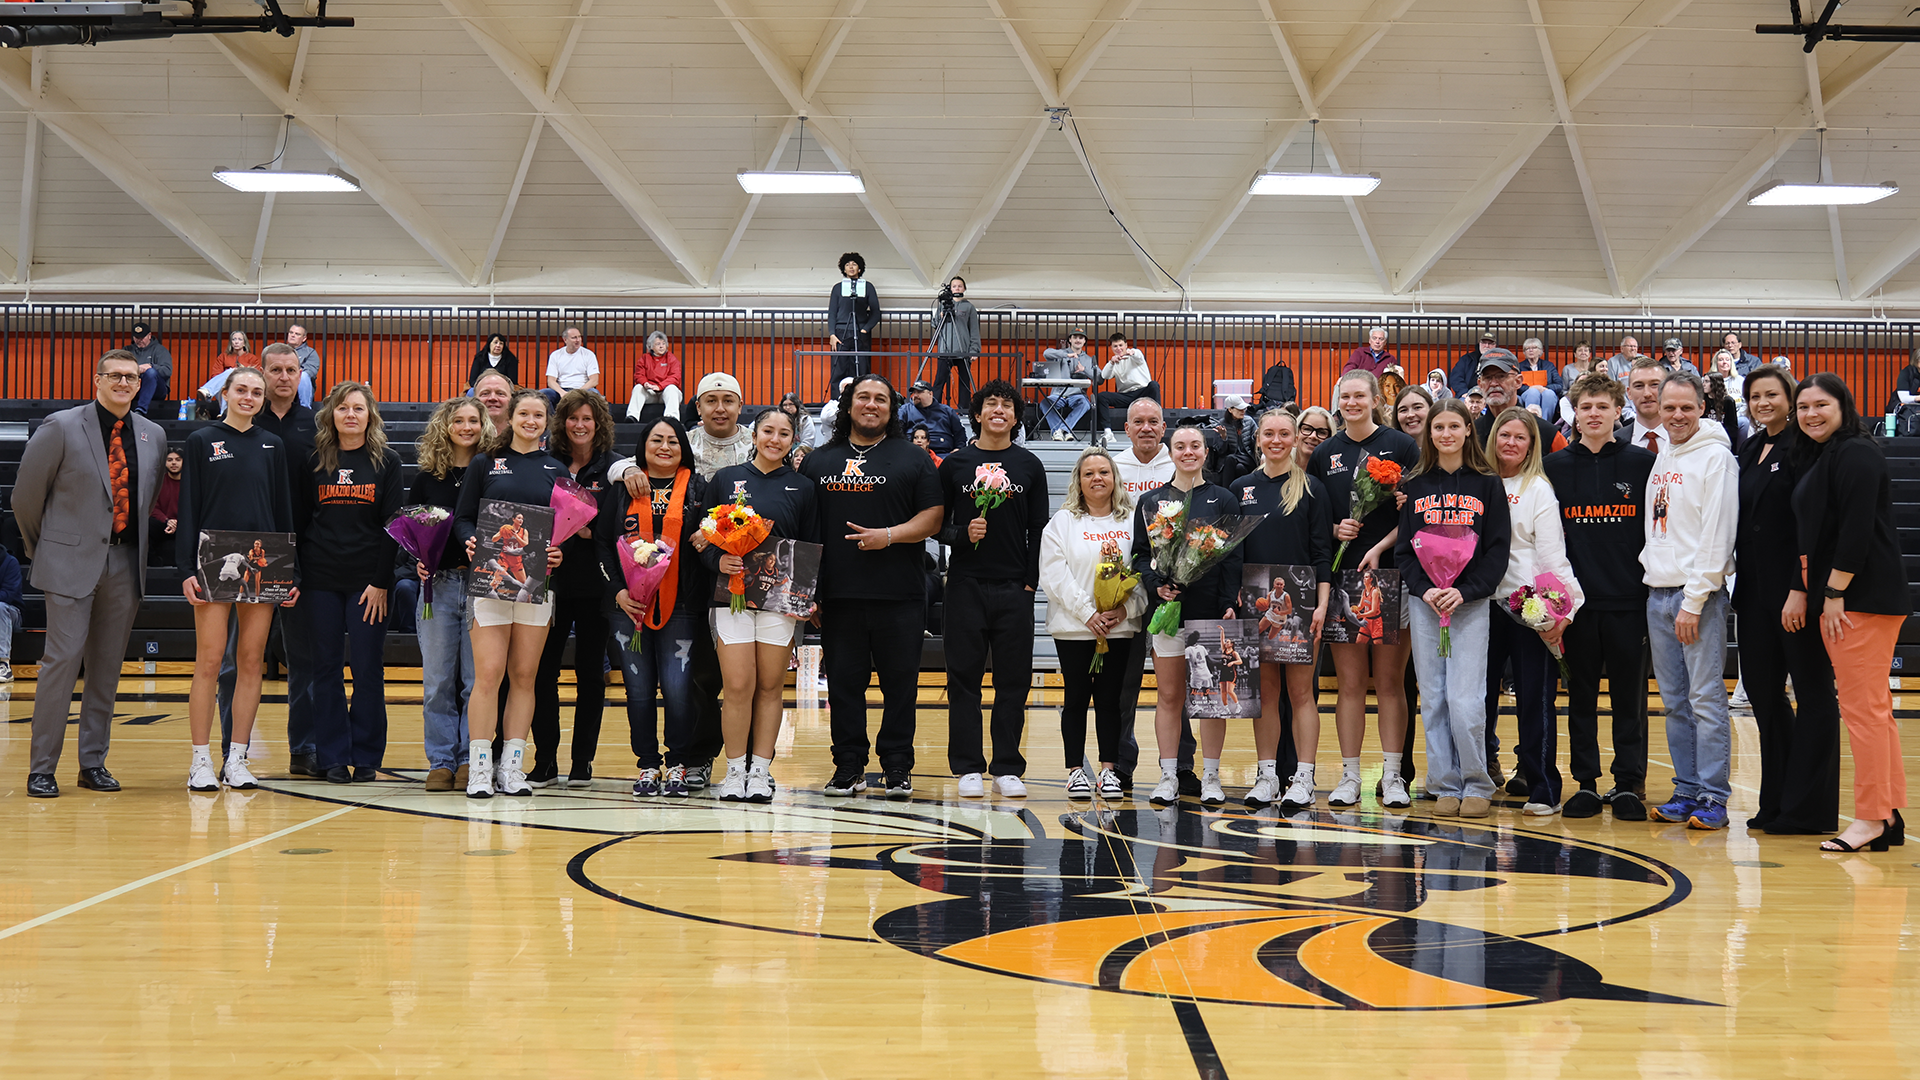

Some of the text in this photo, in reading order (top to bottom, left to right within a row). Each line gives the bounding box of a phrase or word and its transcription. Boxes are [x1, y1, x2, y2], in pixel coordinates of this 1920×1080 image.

[842, 458, 867, 476] K
[337, 469, 354, 484] K
[820, 475, 887, 485] KALAMAZOO
[826, 482, 874, 492] COLLEGE
[1122, 480, 1165, 492] SENIOR
[350, 484, 376, 502] COLLEGE
[1415, 494, 1484, 515] KALAMAZOO
[1424, 509, 1474, 525] COLLEGE
[1564, 505, 1636, 518] KALAMAZOO
[1083, 530, 1131, 541] SENIORS
[760, 582, 771, 591] 33
